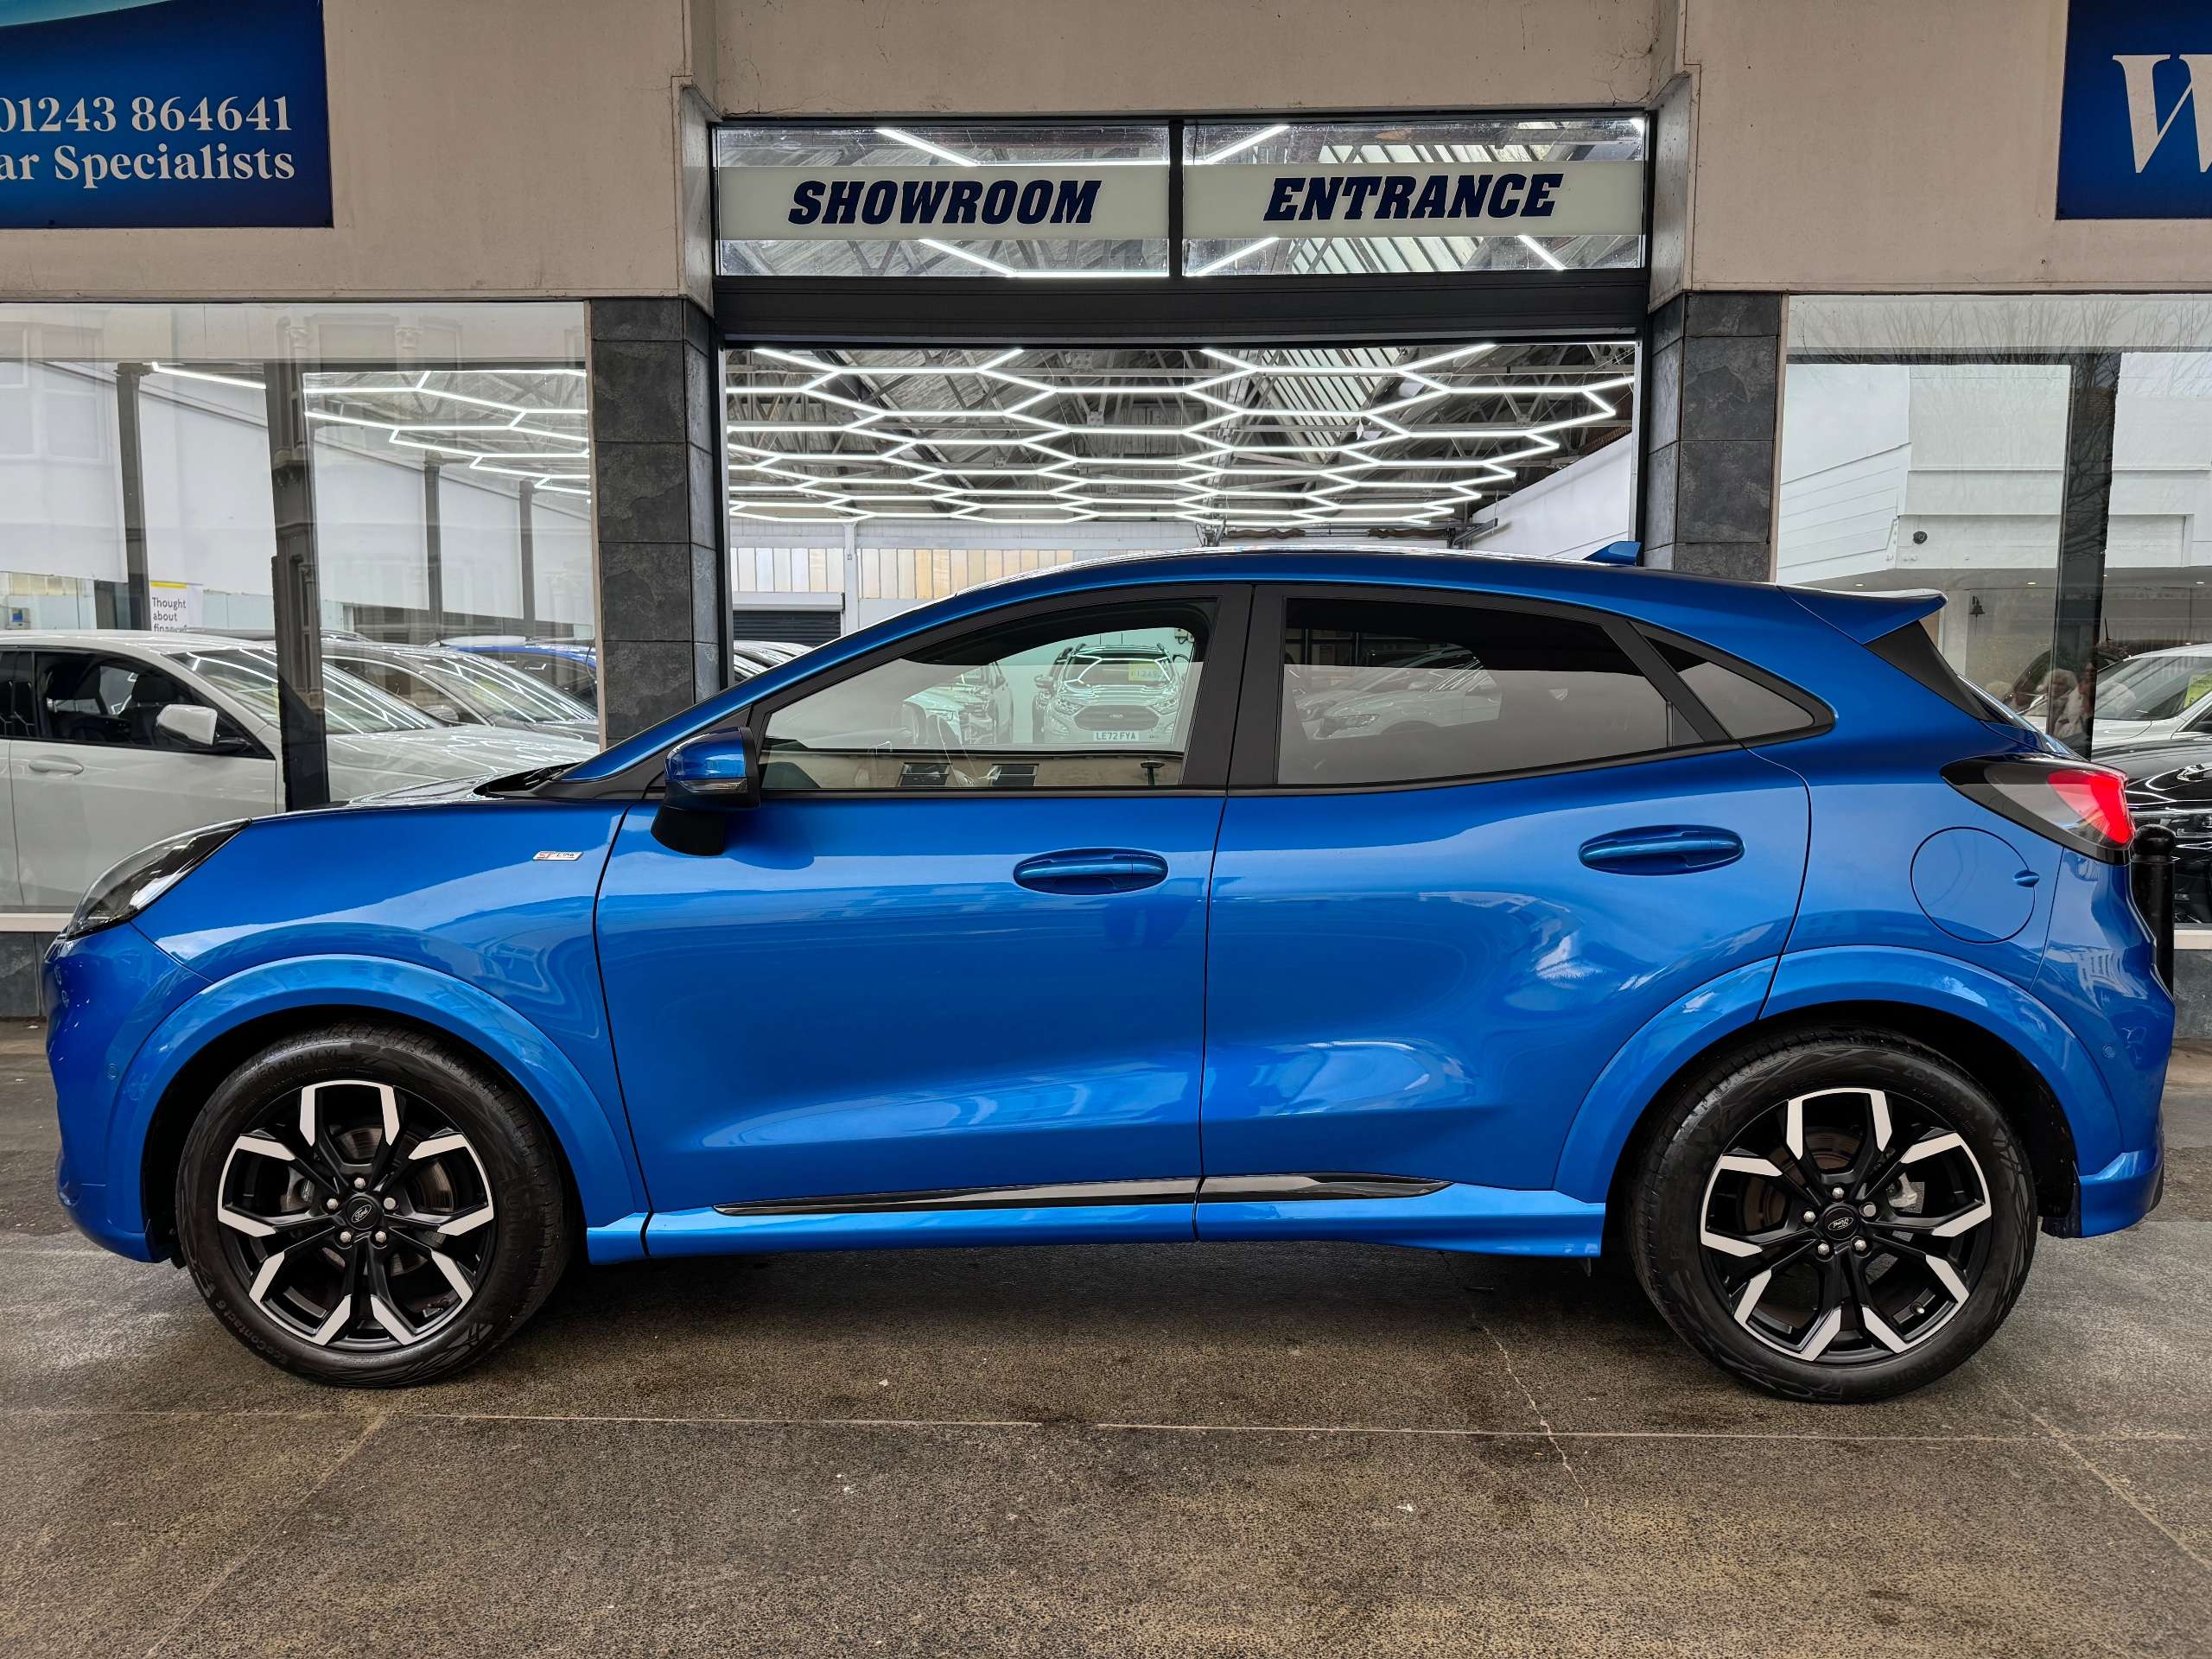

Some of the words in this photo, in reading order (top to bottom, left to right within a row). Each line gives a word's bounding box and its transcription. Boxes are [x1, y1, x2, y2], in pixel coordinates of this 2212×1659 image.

[0, 96, 118, 132] 01243
[131, 96, 292, 131] 864641
[54, 143, 295, 189] Specialists
[787, 179, 1103, 225] SHOWROOM
[1262, 173, 1565, 222] ENTRANCE
[152, 597, 187, 610] Thought
[153, 610, 178, 621] about
[1119, 732, 1136, 741] FYA
[353, 1206, 369, 1221] Ford
